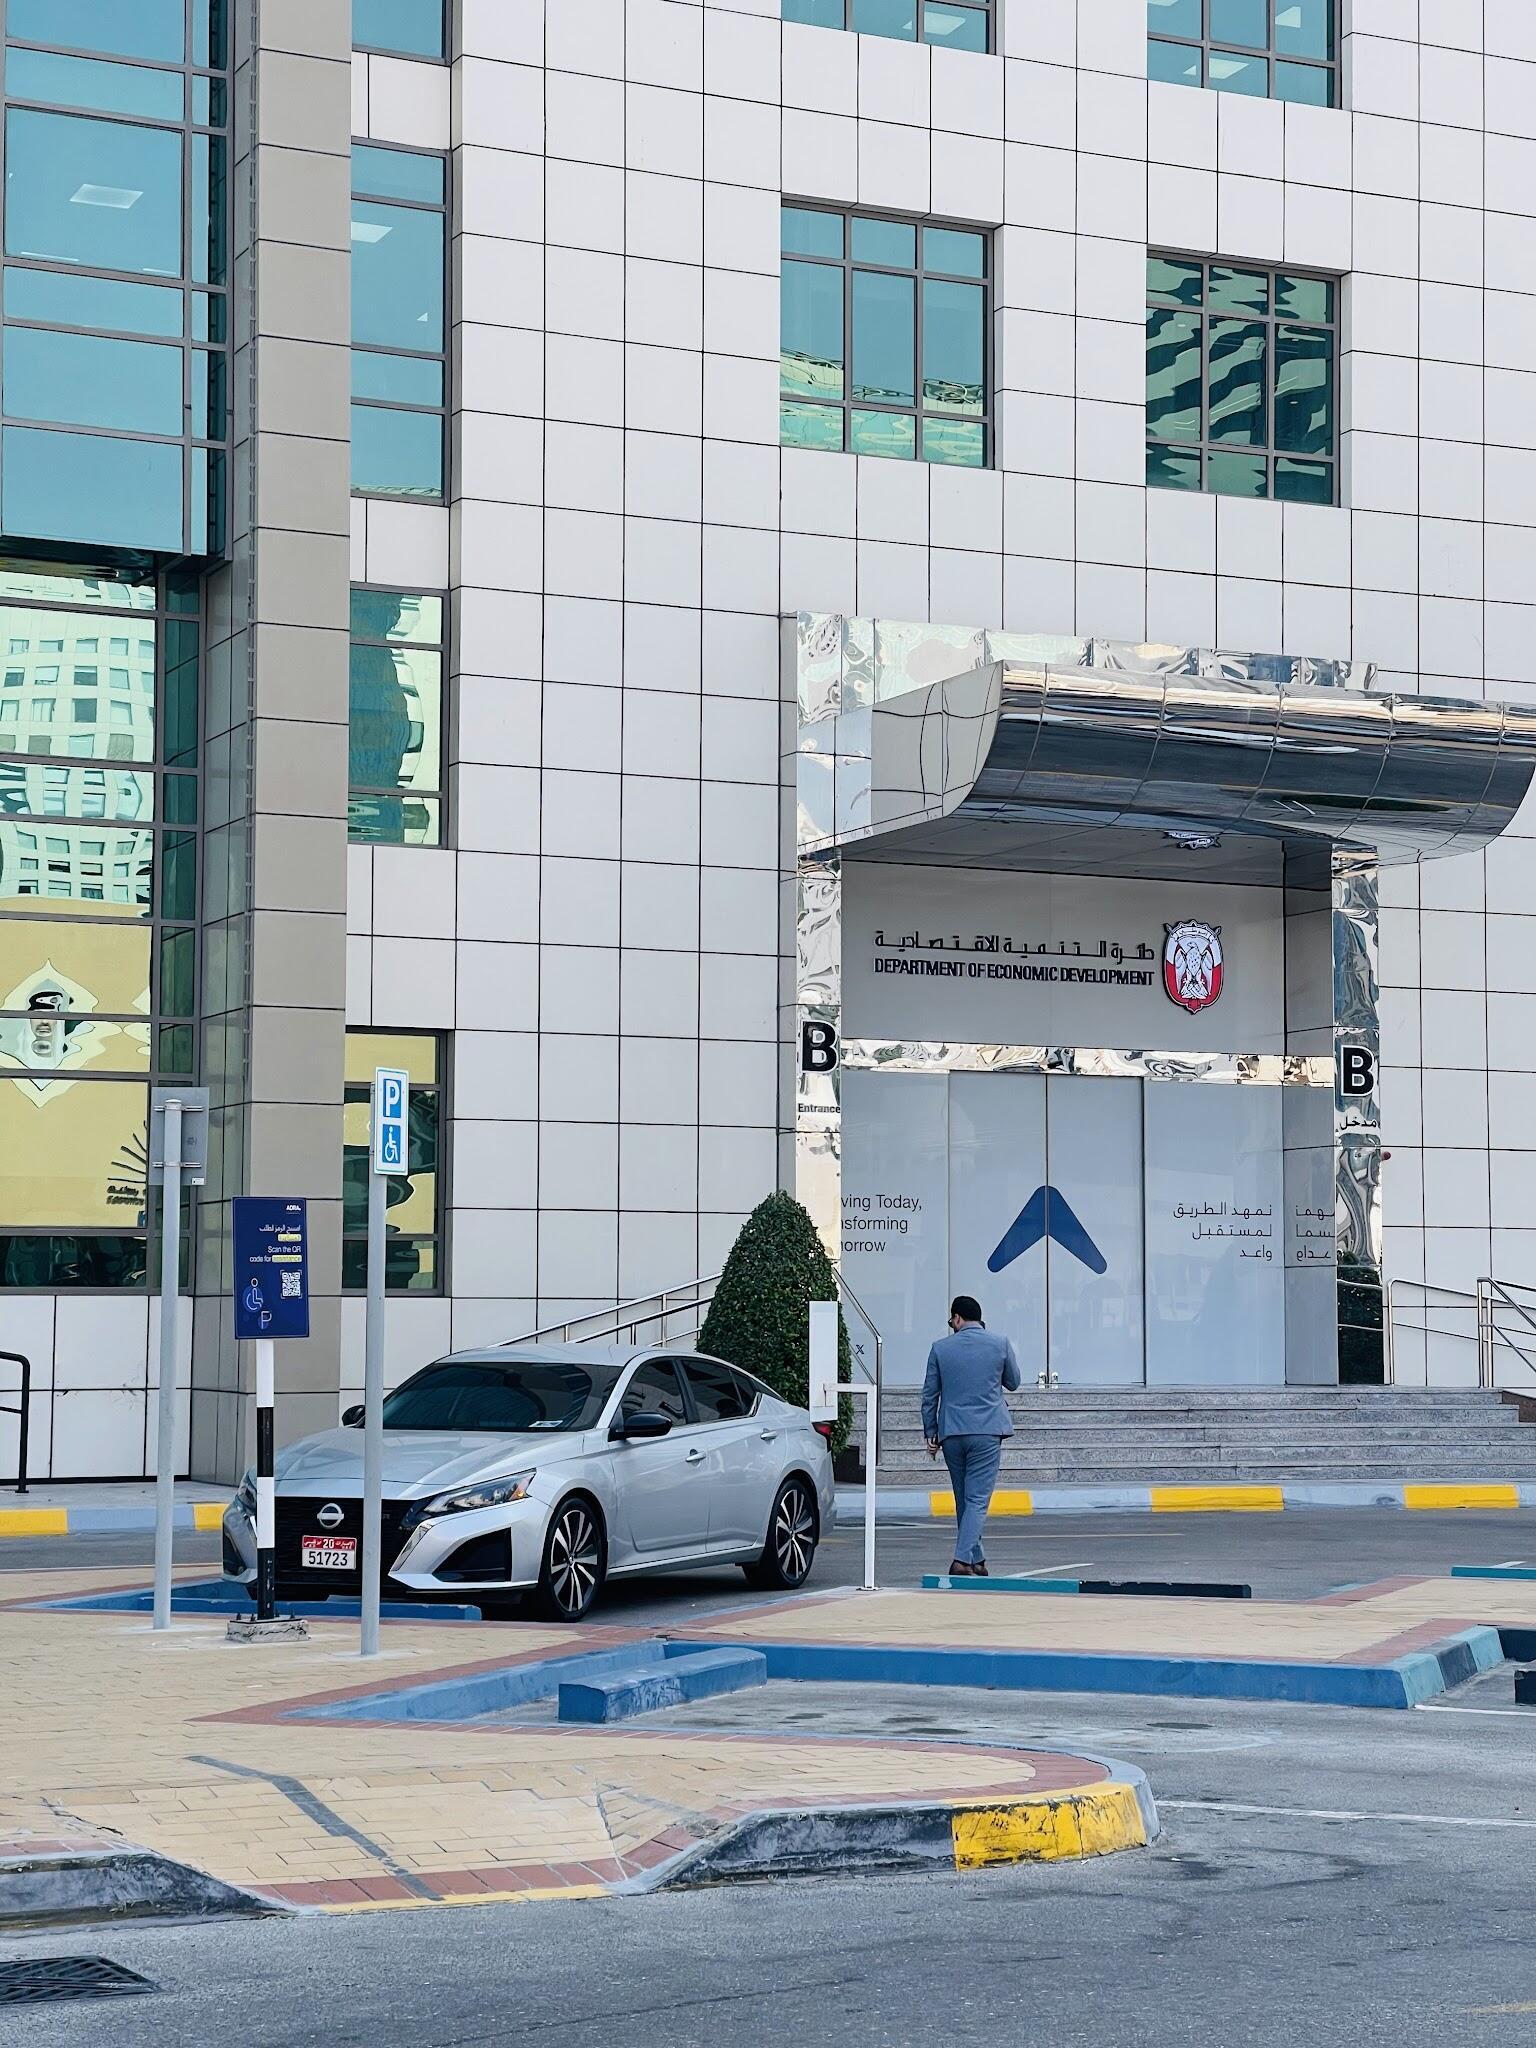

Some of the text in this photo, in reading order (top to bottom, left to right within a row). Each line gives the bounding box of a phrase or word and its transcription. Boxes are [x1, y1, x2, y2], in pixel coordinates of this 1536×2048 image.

[875, 930, 999, 953] الاقتصادية
[1003, 937, 1107, 959] التنمية
[874, 958, 1155, 986] DEPARTMENT OF ECONOMIC DEVELOPMENT
[801, 1020, 839, 1073] B
[1341, 1044, 1375, 1096] B
[386, 1080, 399, 1116] P
[797, 1102, 841, 1114] Entrance
[1340, 1115, 1377, 1130] مدخل
[875, 1193, 922, 1213] Today,
[1173, 1201, 1272, 1220] نمهد الطريق
[1192, 1222, 1272, 1240] لمستقبل
[267, 1245, 282, 1253] Scan
[1240, 1244, 1273, 1261] واعد
[249, 1255, 264, 1263] code
[264, 1254, 272, 1263] for
[322, 1538, 335, 1549] 20
[308, 1551, 348, 1566] 51723
